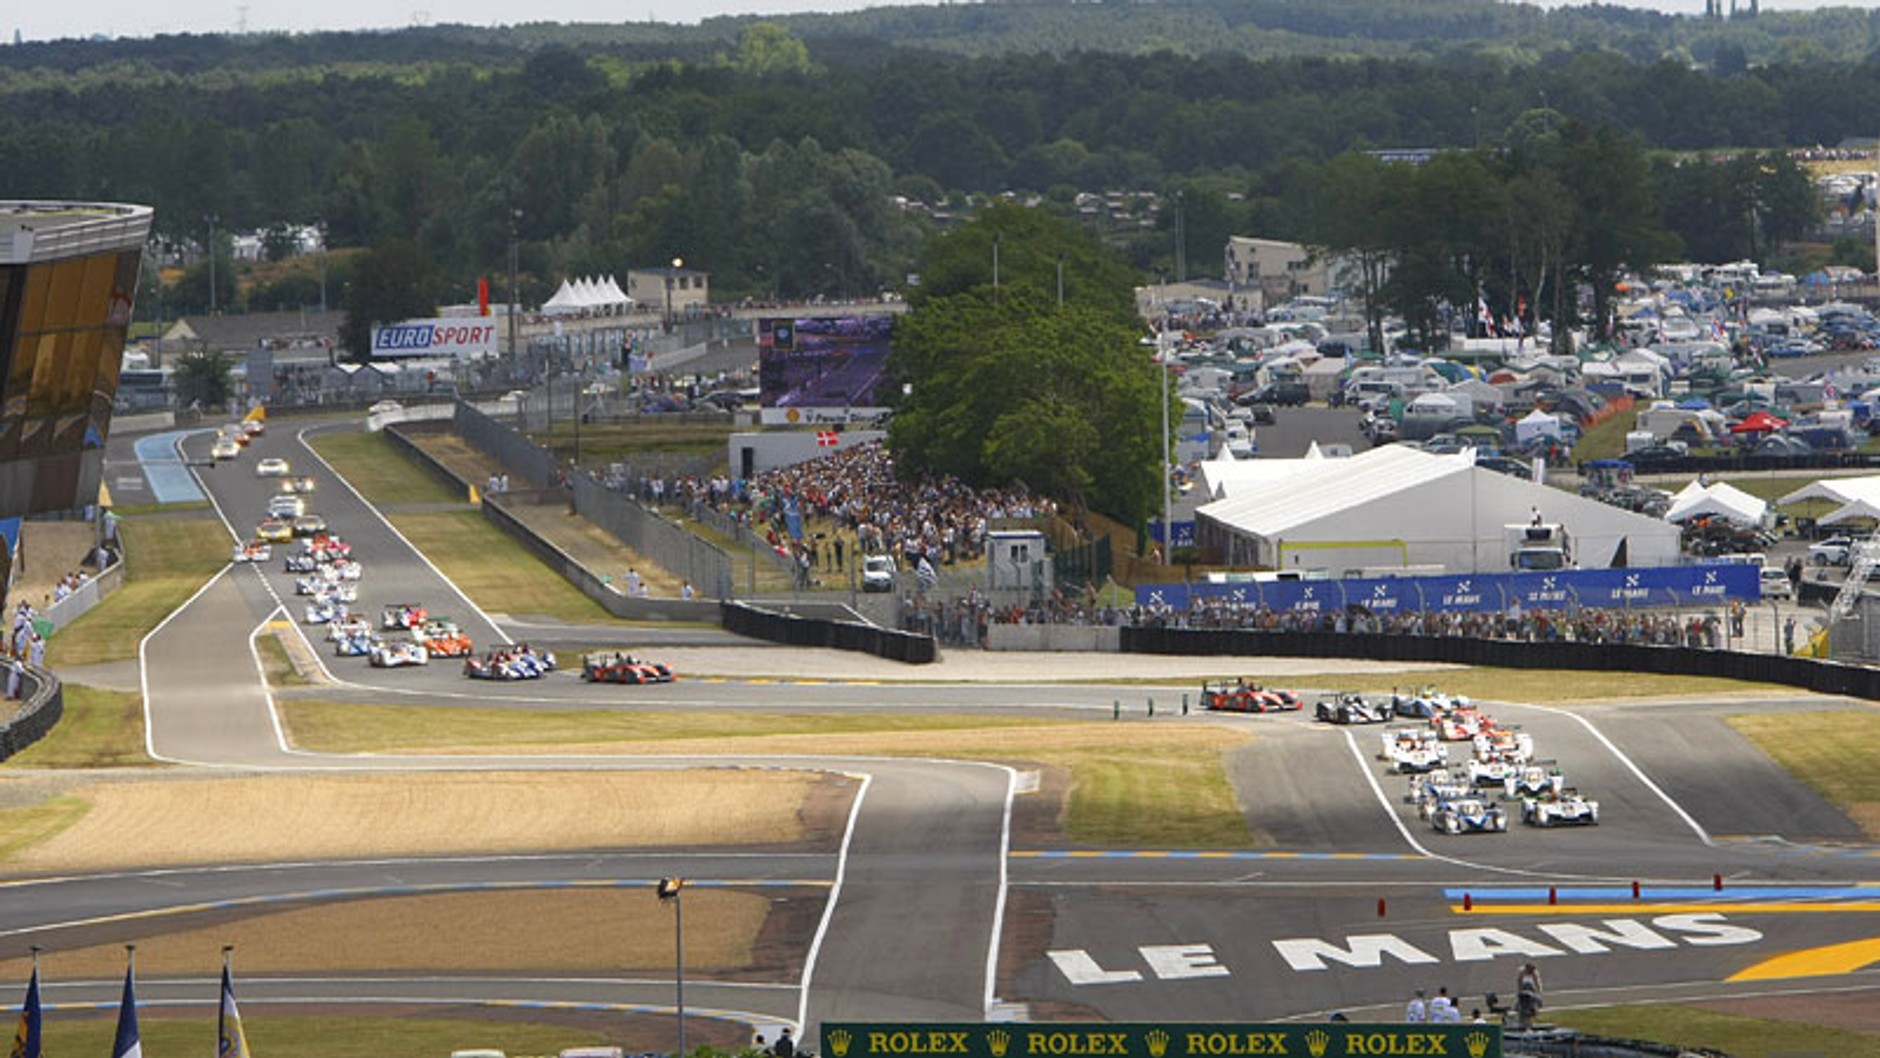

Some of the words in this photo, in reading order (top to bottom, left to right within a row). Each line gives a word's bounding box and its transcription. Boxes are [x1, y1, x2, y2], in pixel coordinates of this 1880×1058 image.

[378, 325, 495, 347] EUROSPORT
[1048, 945, 1230, 983] LE
[1272, 913, 1763, 970] MANS
[868, 1033, 968, 1053] ROLEX
[1027, 1033, 1127, 1053] ROLEX
[1186, 1033, 1286, 1053] ROLEX
[1345, 1033, 1447, 1053] ROLEX
